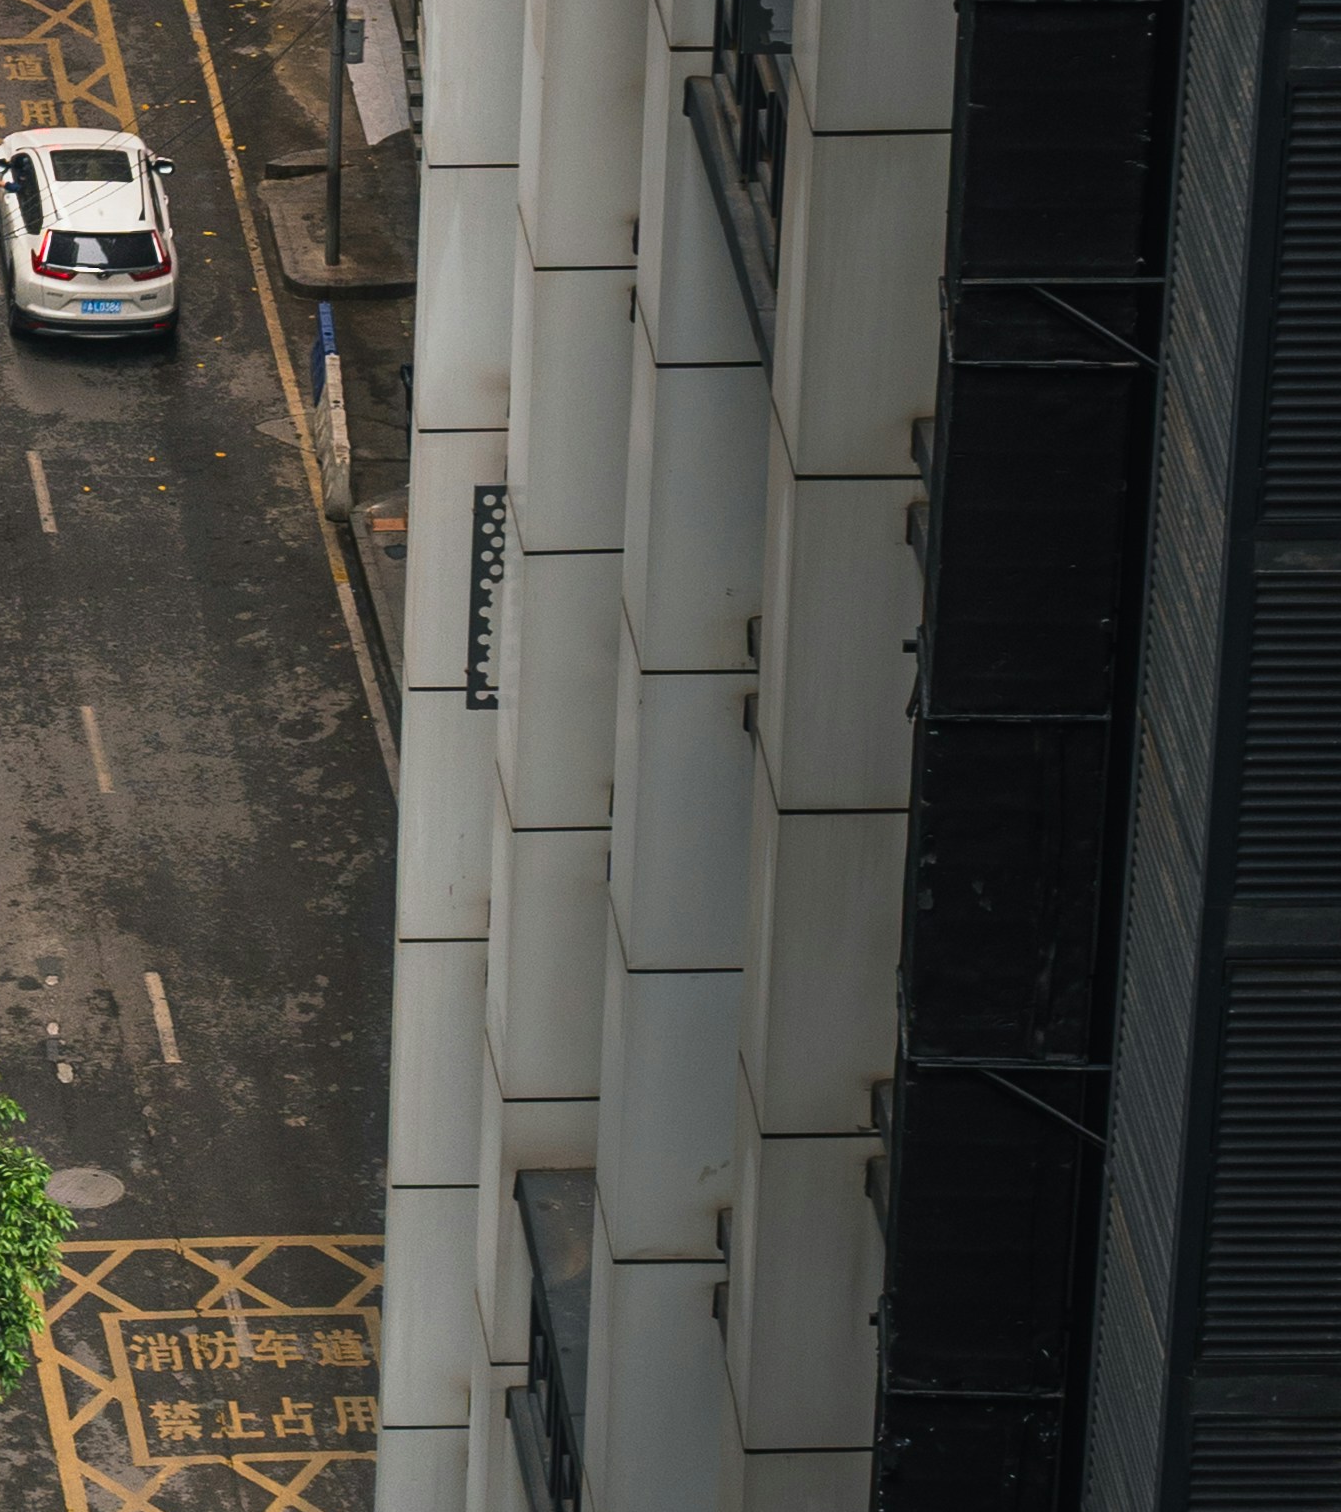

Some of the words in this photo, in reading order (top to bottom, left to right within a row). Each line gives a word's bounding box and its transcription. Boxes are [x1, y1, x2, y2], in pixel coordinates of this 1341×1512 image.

[128, 1329, 372, 1371] 消防车道
[149, 1395, 379, 1442] 禁止占用
